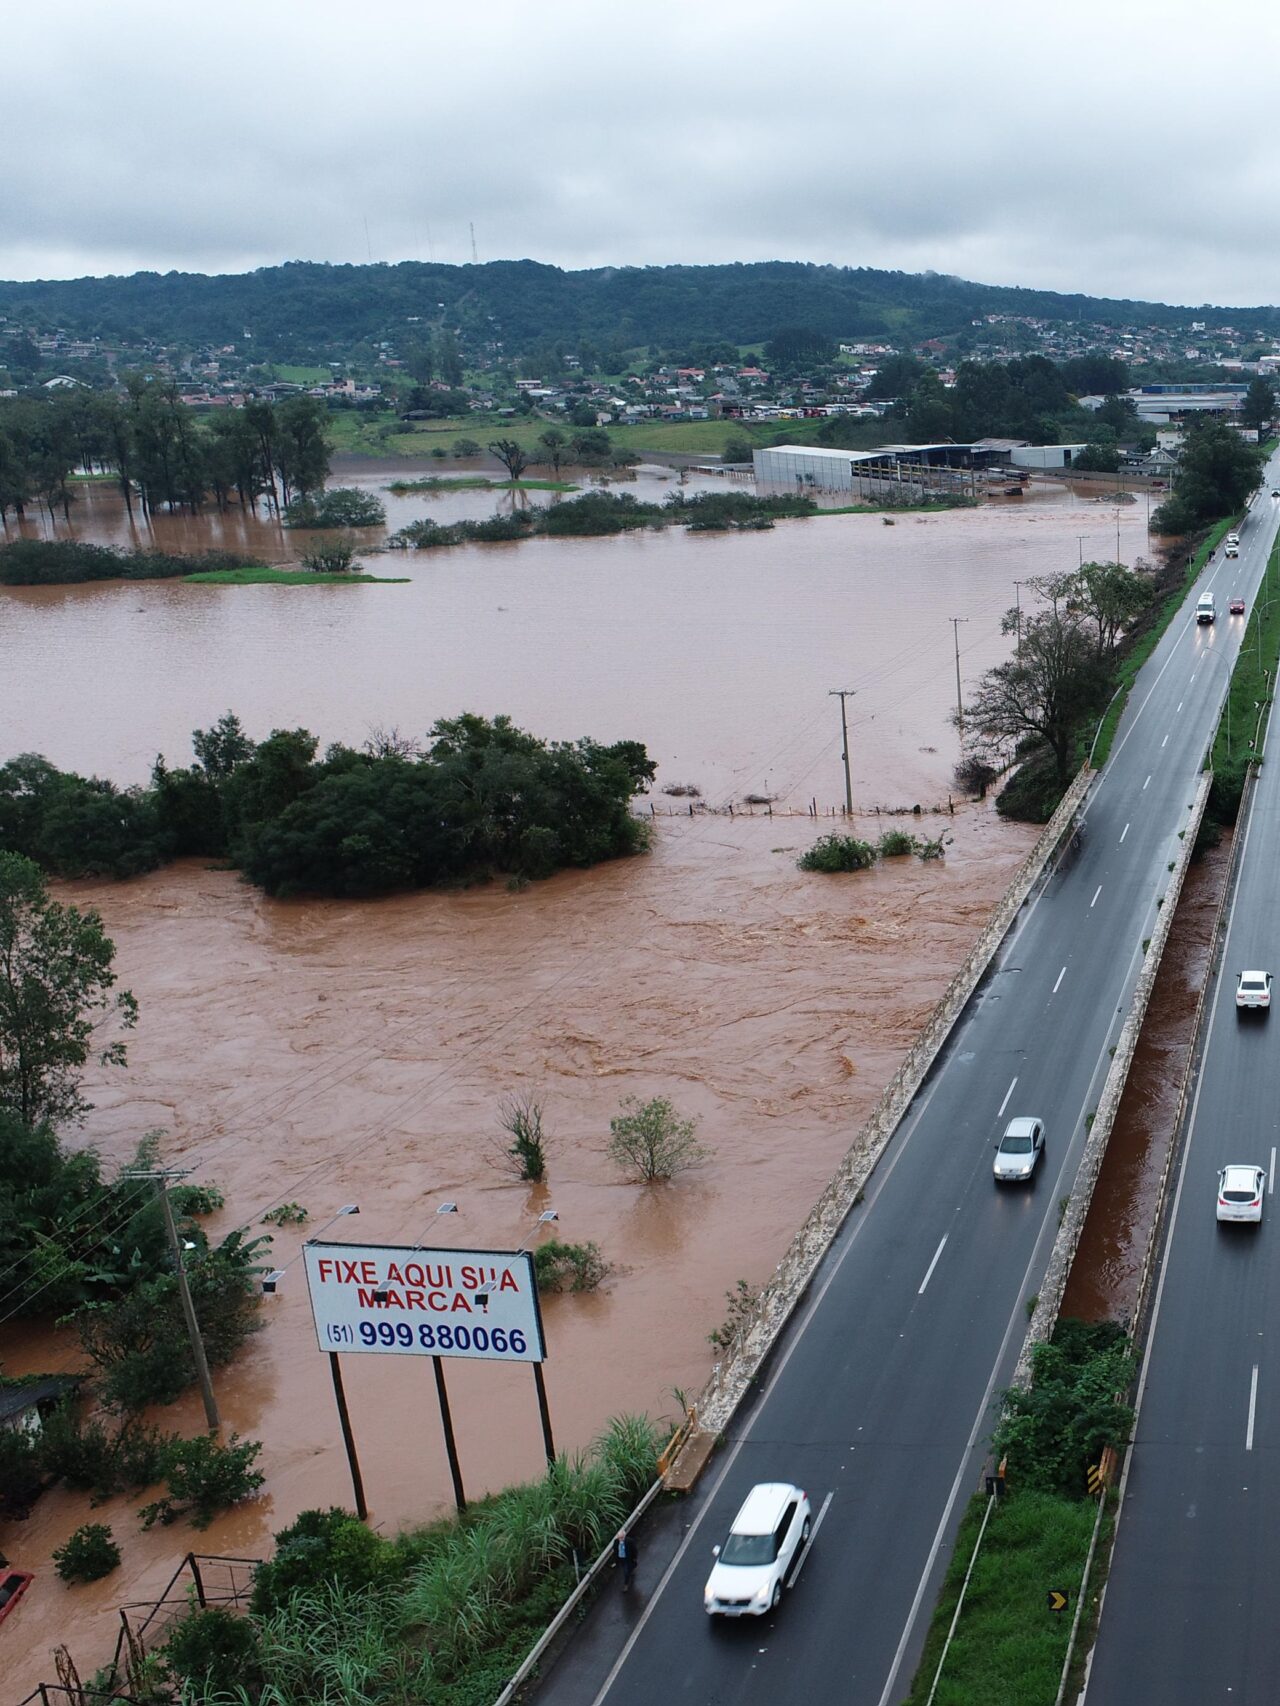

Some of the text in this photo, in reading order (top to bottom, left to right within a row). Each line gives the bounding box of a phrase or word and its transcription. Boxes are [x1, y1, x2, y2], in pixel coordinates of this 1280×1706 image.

[318, 1259, 519, 1292] FIXE AQUI SUA
[326, 1323, 354, 1344] (51)
